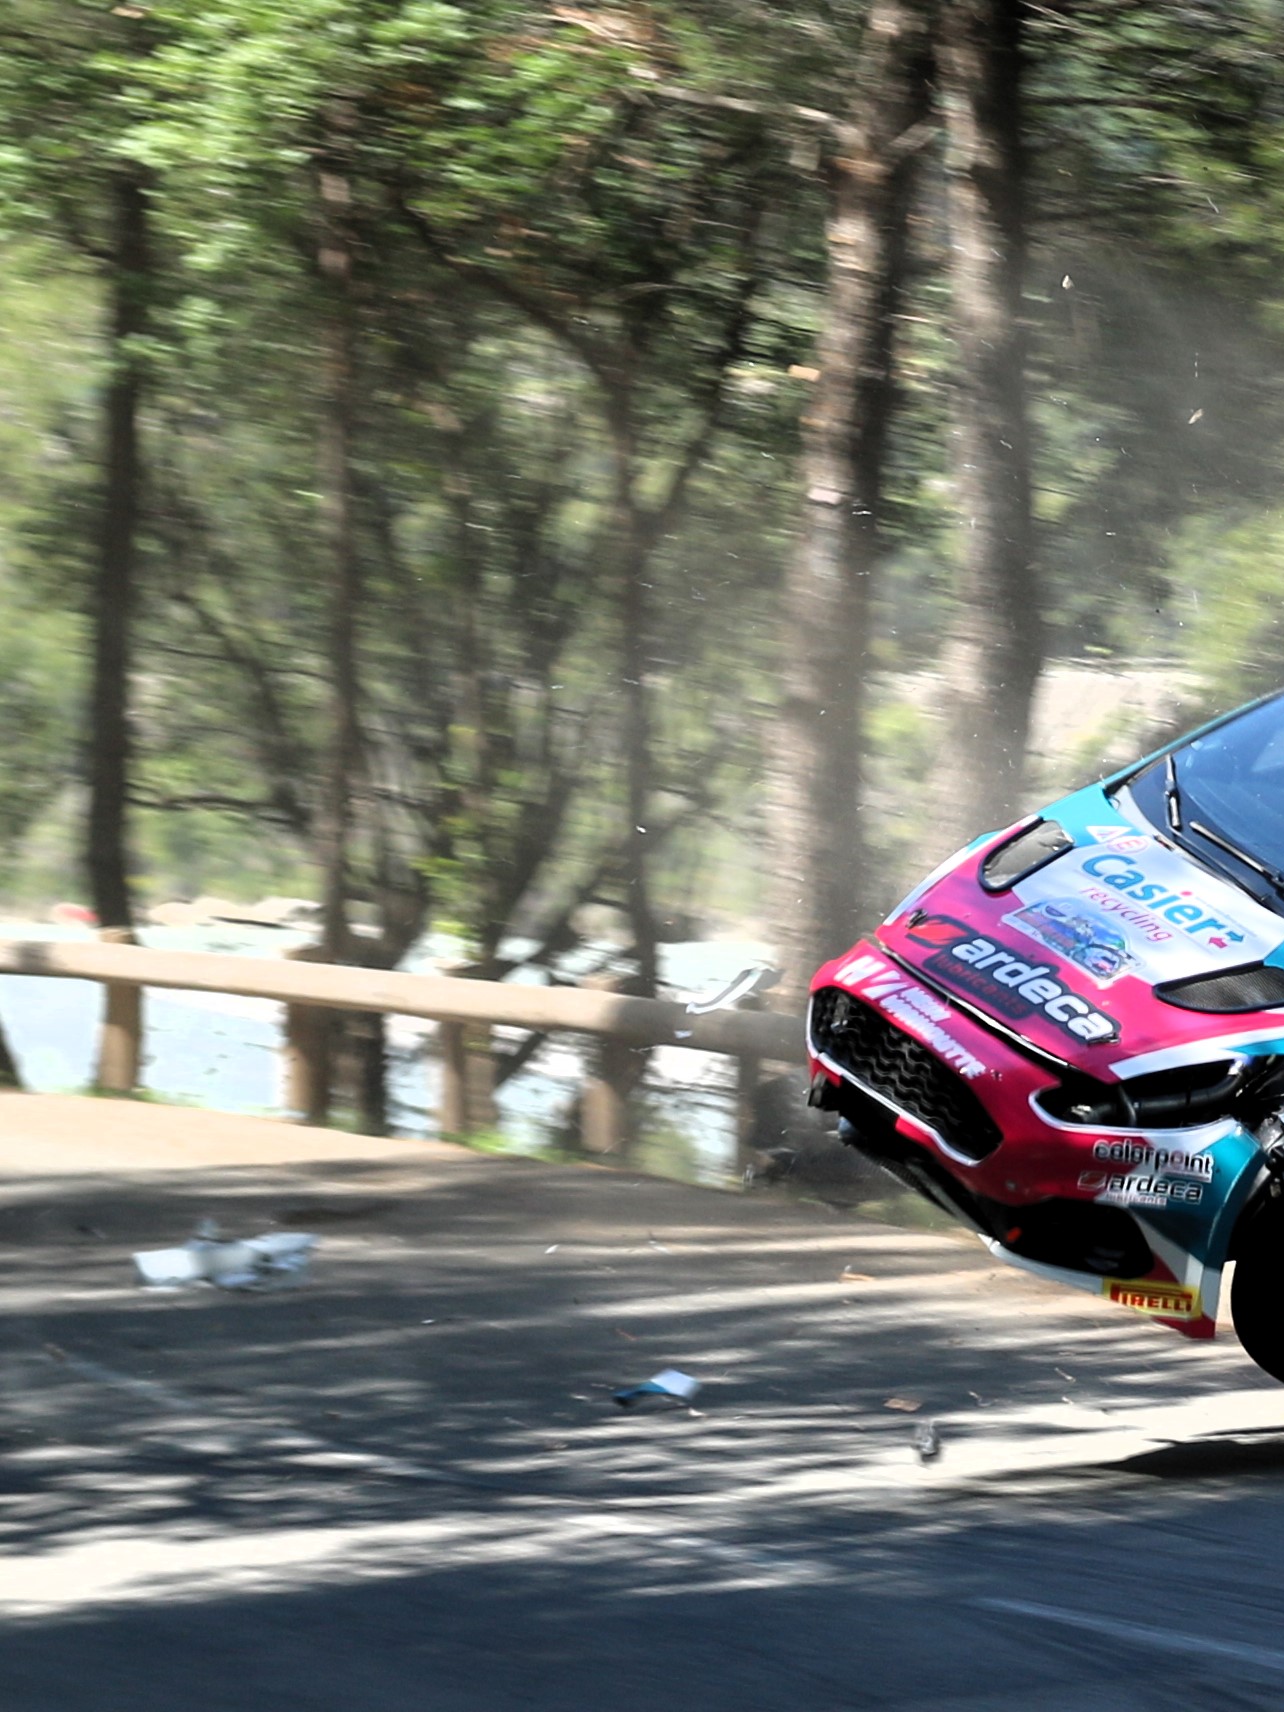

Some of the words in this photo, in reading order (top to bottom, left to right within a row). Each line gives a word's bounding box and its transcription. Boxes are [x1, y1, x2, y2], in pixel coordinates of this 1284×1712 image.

[1079, 885, 1175, 943] recycling
[1082, 854, 1227, 934] Casier
[951, 937, 1117, 1041] ardeca
[1093, 1138, 1213, 1174] colorpoint
[1107, 1173, 1202, 1205] ardeca
[1110, 1283, 1193, 1313] PIRELLI
